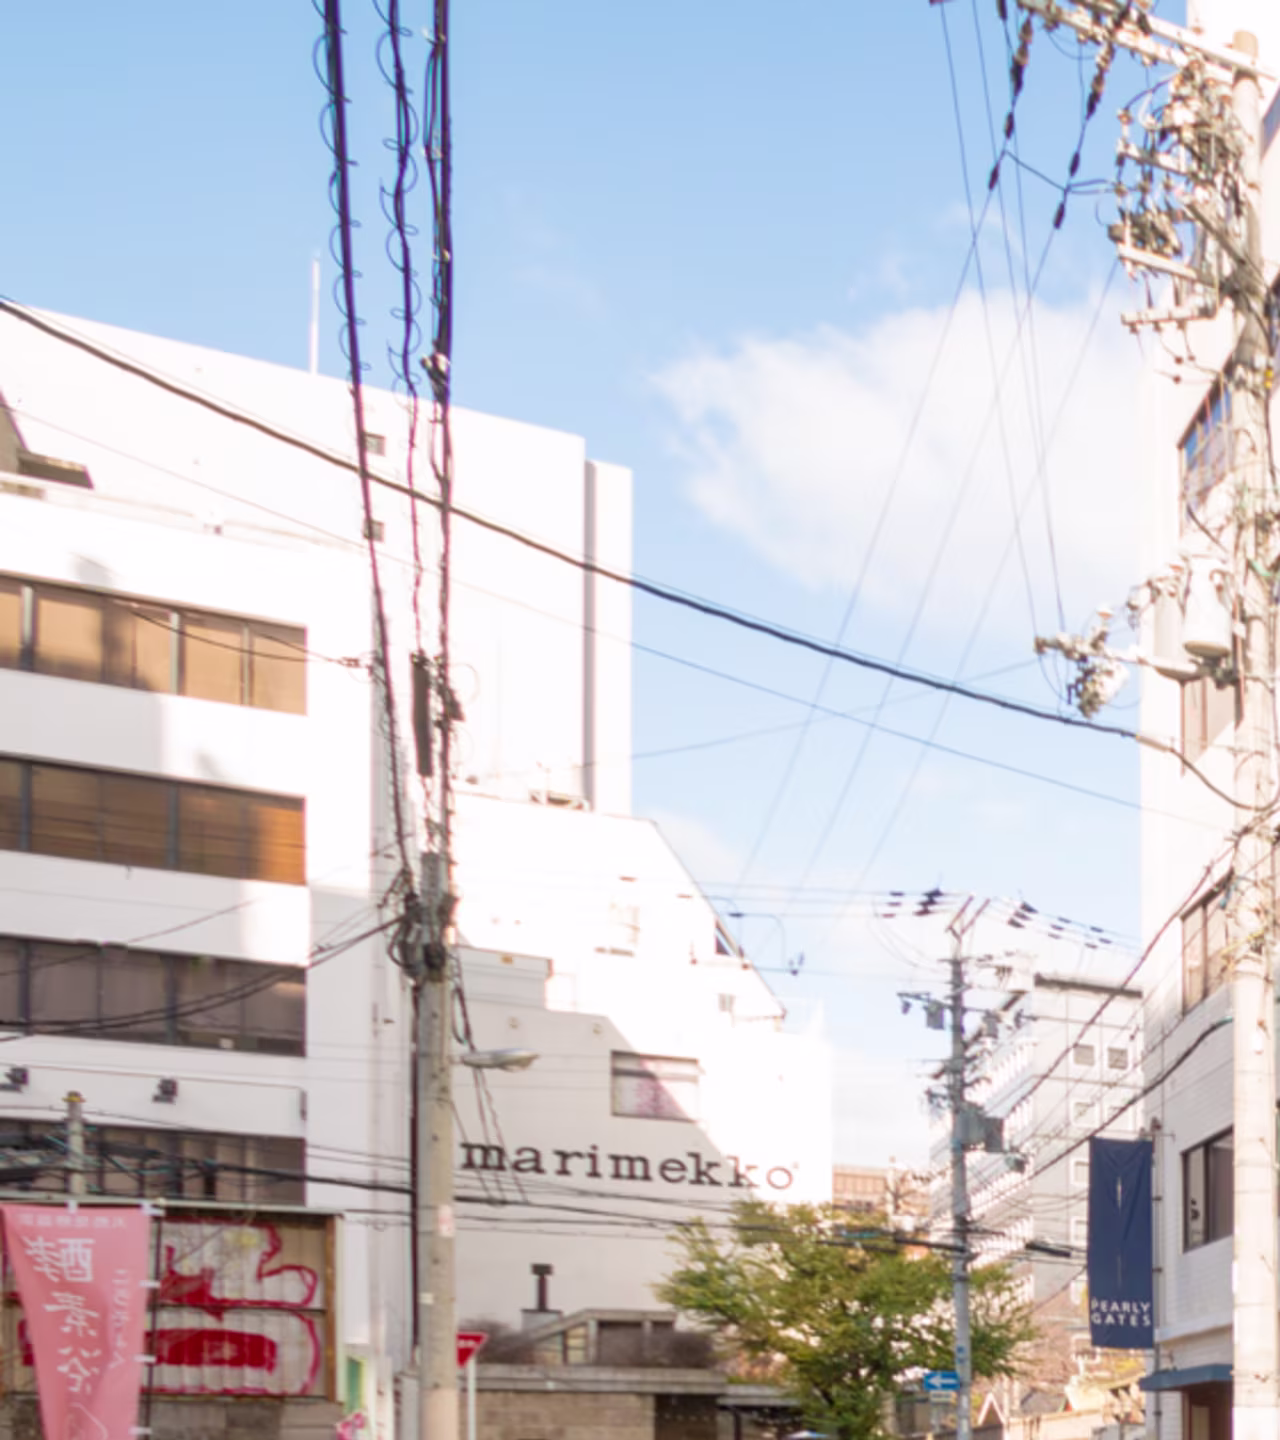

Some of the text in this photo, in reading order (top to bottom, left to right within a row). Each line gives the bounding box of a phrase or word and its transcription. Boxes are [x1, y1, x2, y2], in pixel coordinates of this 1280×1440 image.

[458, 1142, 795, 1192] marimekko
[1090, 1297, 1151, 1314] PEARLY
[1090, 1312, 1151, 1328] GATES
